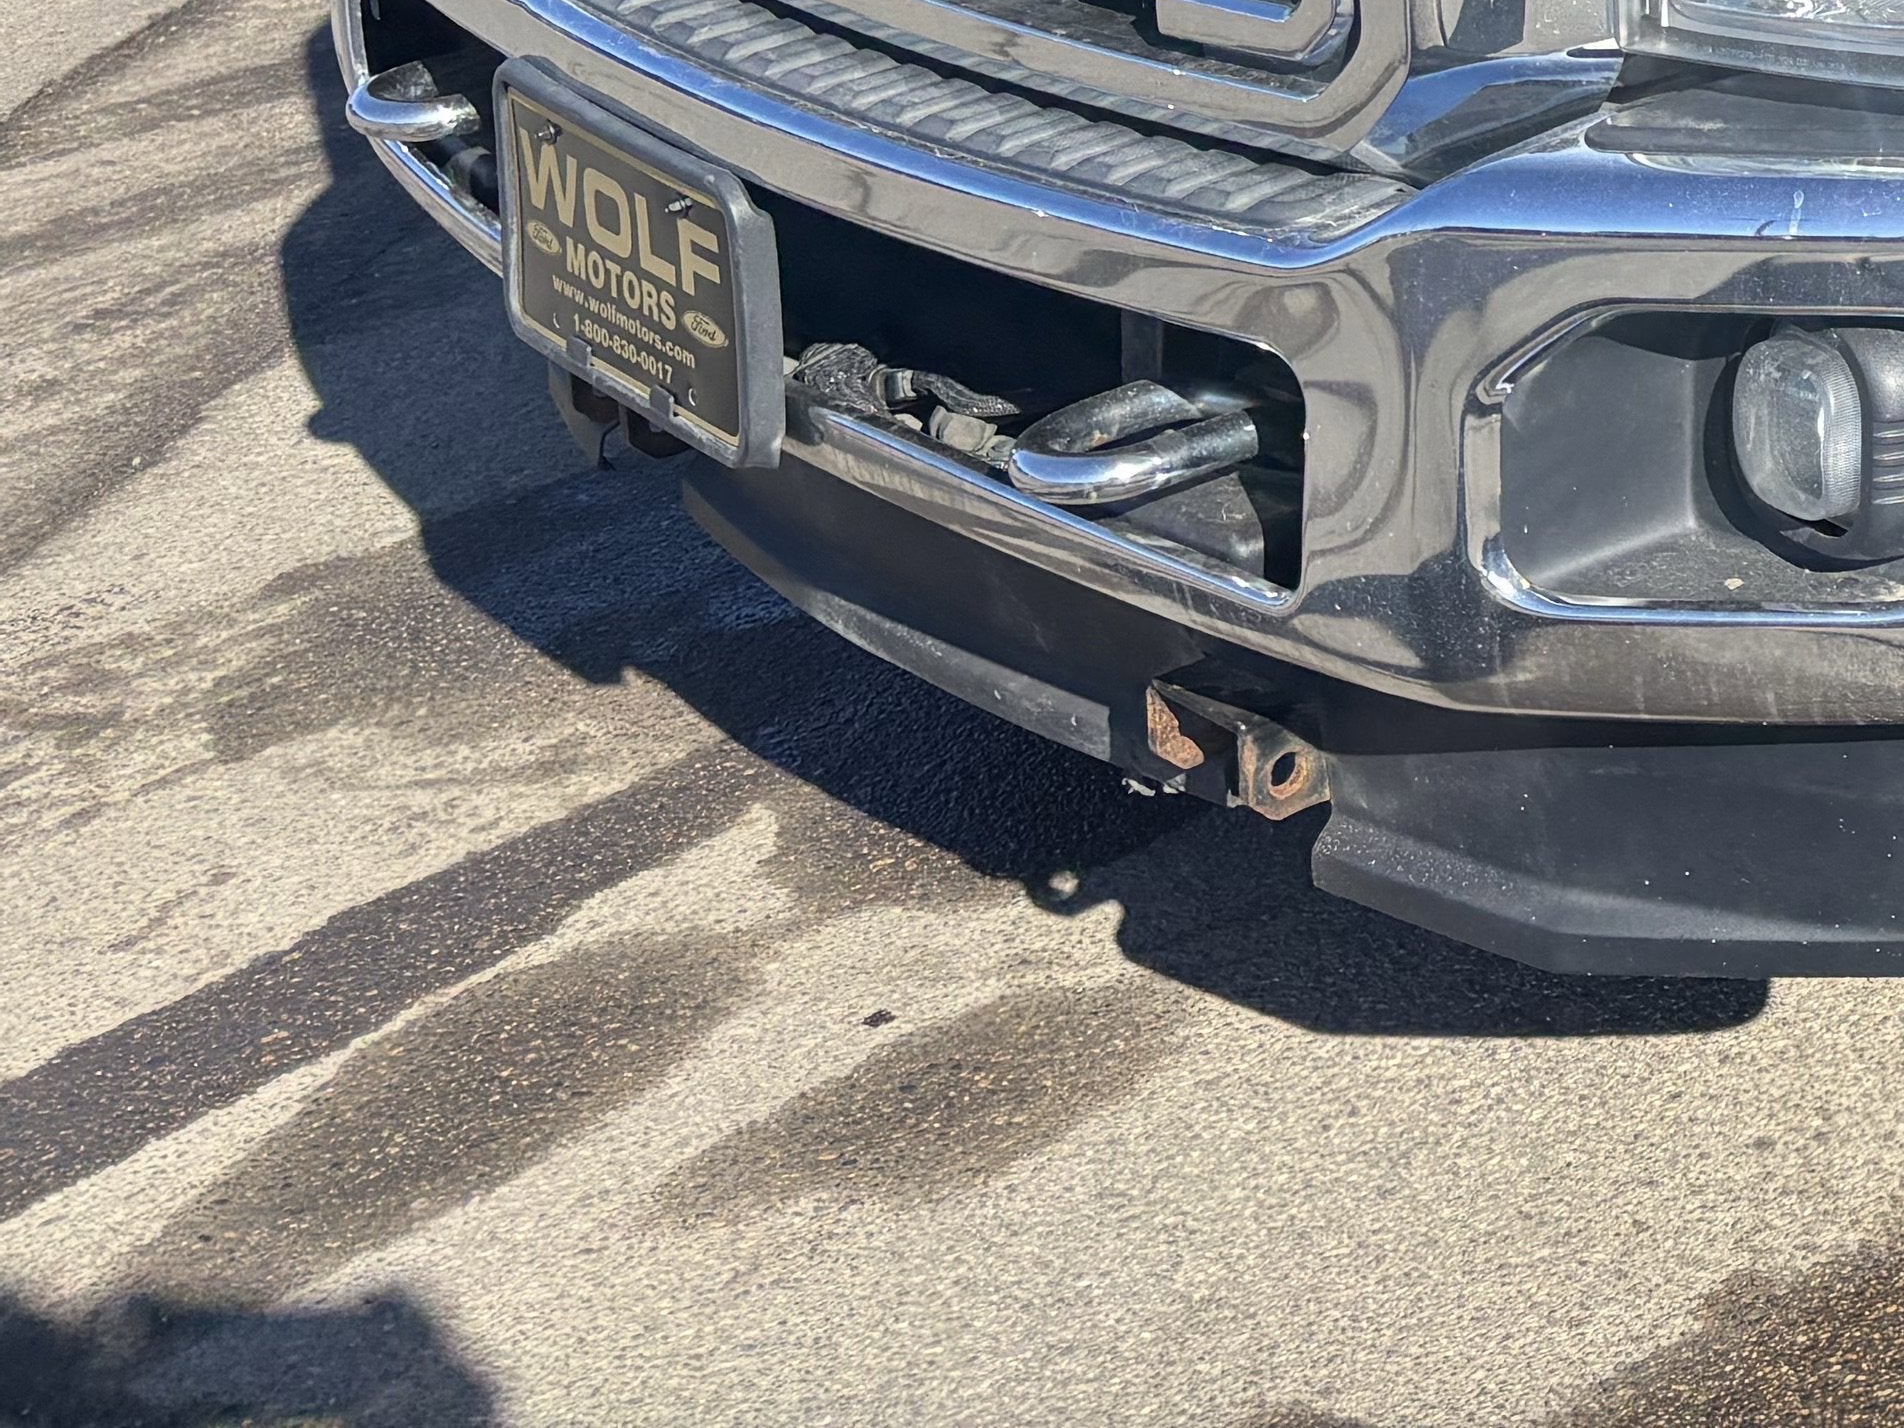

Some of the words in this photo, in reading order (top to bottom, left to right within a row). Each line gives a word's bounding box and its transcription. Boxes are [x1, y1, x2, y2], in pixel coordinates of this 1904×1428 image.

[520, 126, 721, 296] WOLF
[551, 274, 696, 369] www.wolfmotors.com
[566, 236, 677, 330] MOTORS
[573, 313, 673, 384] 1-800-830-0017
